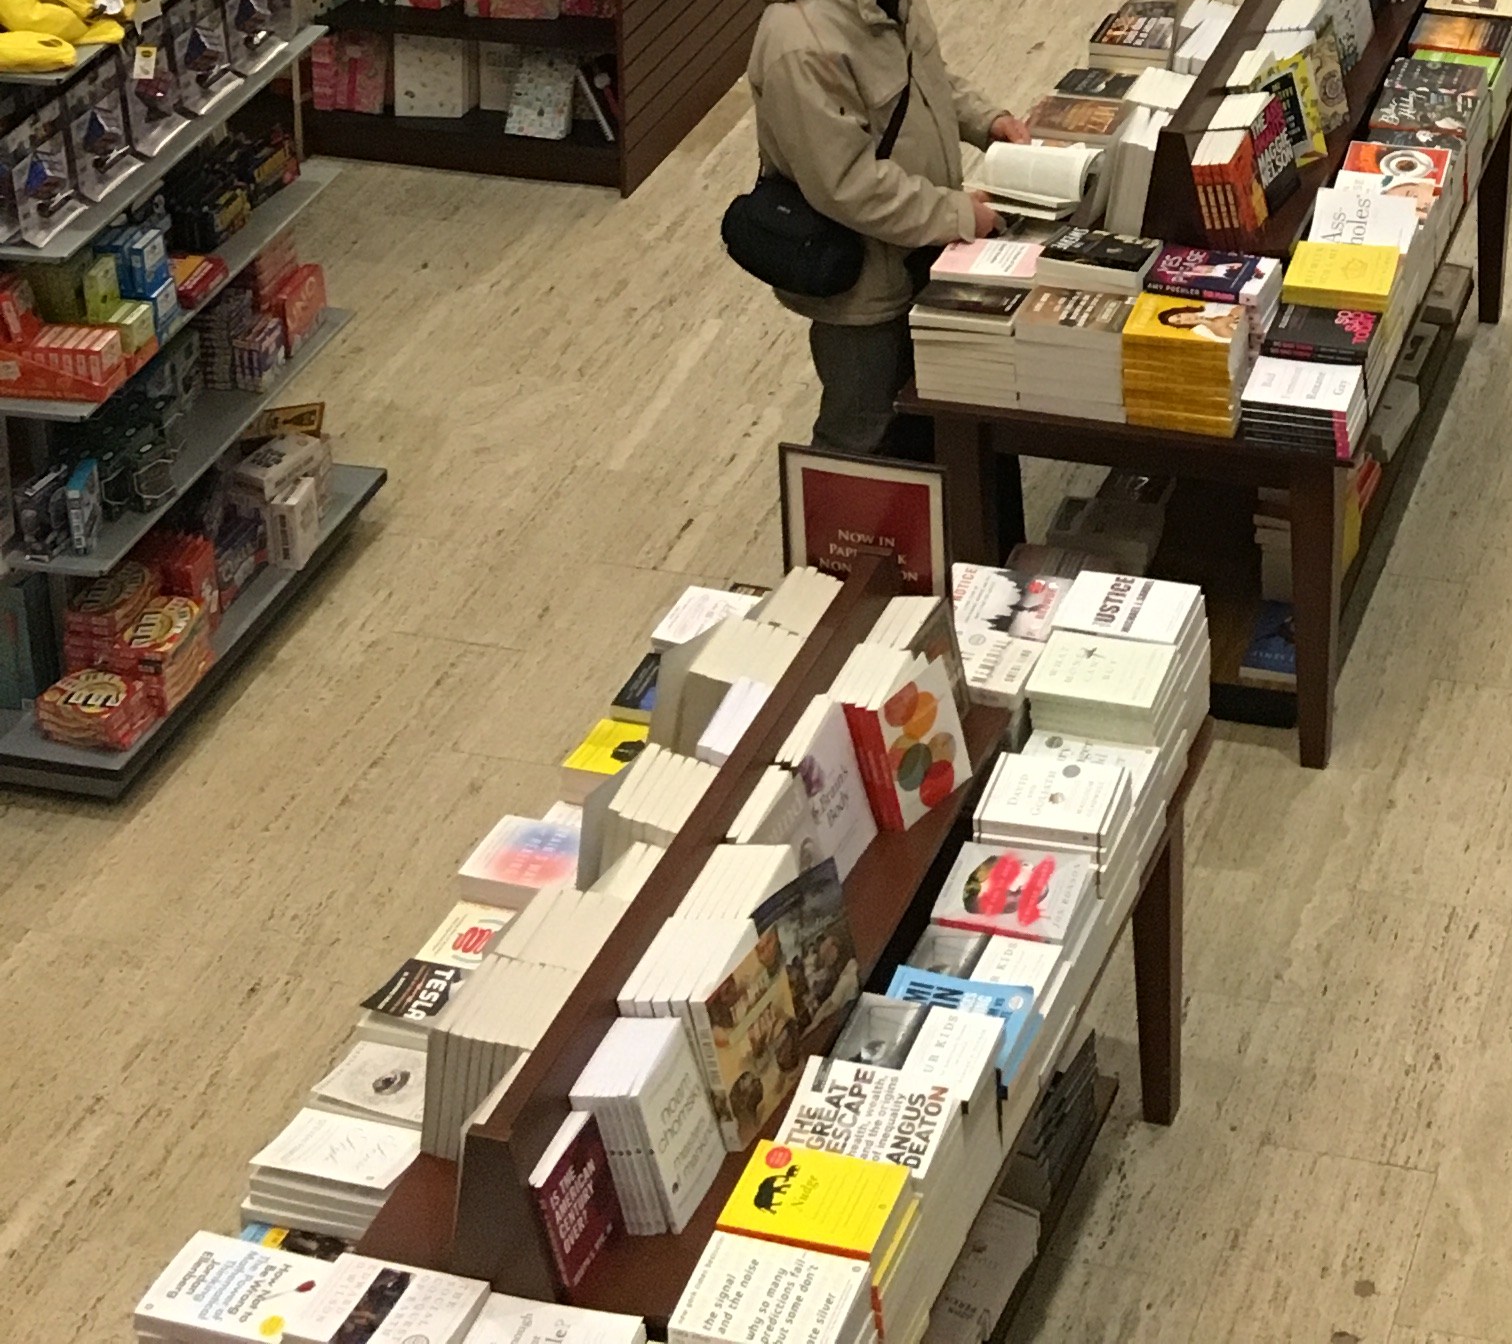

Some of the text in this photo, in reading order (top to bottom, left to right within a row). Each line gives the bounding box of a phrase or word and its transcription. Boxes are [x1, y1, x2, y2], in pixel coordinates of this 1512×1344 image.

[1251, 113, 1267, 139] THE
[1257, 130, 1291, 165] MAGGIE
[1261, 146, 1295, 187] NELSON
[1158, 253, 1183, 272] YES
[1147, 281, 1200, 296] AMY POEHLER
[838, 529, 896, 547] NOW IN
[402, 968, 456, 1021] TESLA
[805, 1078, 851, 1151] GREAT
[825, 1068, 876, 1155] ESCAPE
[877, 1075, 899, 1121] origins
[784, 1104, 817, 1146] THE
[886, 1092, 926, 1166] ANGUS
[903, 1085, 949, 1170] DEATON
[555, 1157, 597, 1226] AMERICAN
[559, 1163, 577, 1195] THE
[558, 1179, 595, 1240] CENTURY
[166, 1250, 214, 1300] Ellenberg
[186, 1257, 221, 1297] Jordan
[233, 1265, 277, 1316] Be Wrong
[239, 1263, 293, 1323] How Not to
[717, 1258, 760, 1335] and the noise
[787, 1291, 805, 1325] some
[800, 1264, 820, 1293] don't
[702, 1273, 737, 1332] the signal
[746, 1267, 790, 1341] why so many
[816, 1292, 837, 1324] silver
